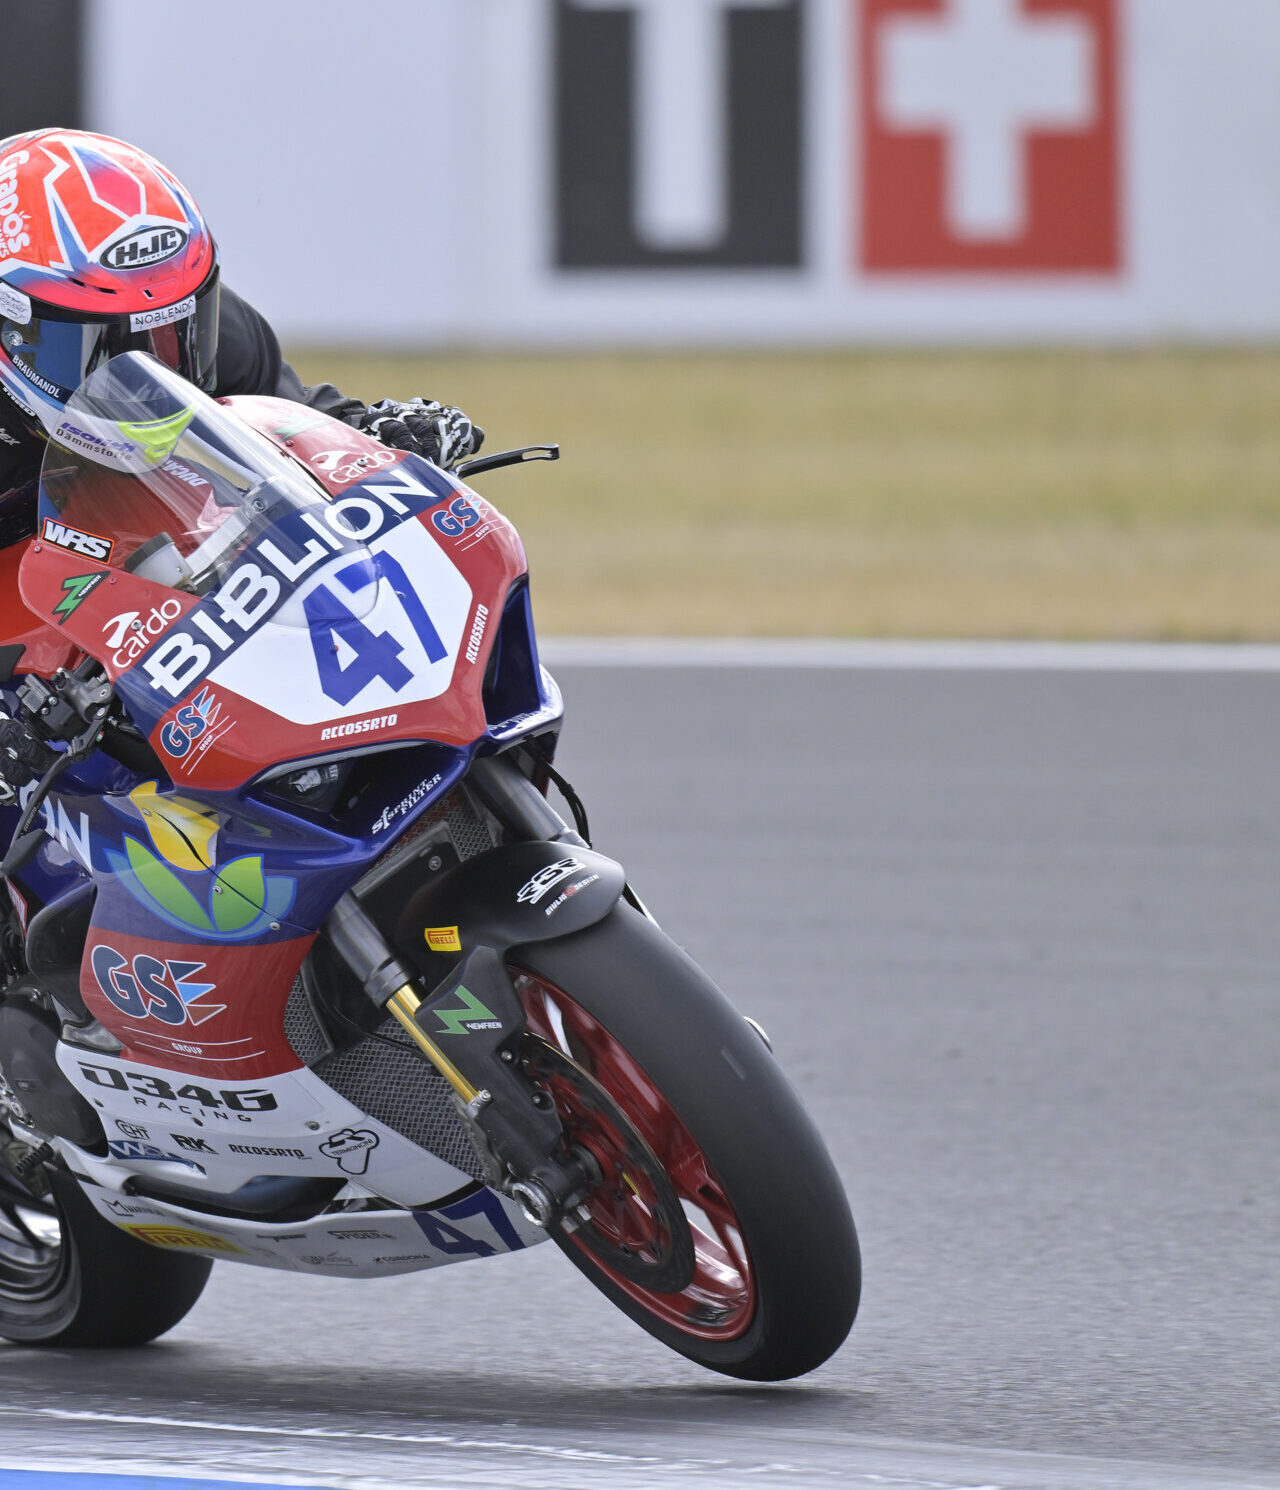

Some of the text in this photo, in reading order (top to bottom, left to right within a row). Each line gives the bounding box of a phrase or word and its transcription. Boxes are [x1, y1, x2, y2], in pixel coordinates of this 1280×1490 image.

[114, 230, 178, 266] HJC
[12, 354, 60, 398] BRAUMANDL
[44, 520, 111, 559] WRS
[143, 469, 437, 697] BIBLION
[112, 599, 182, 668] cardo
[302, 549, 448, 707] 47
[428, 930, 456, 945] PIRELLI
[172, 1042, 203, 1056] GROUP
[77, 1061, 278, 1112] D34G
[135, 1096, 252, 1122] RACING
[412, 1185, 528, 1258] 47
